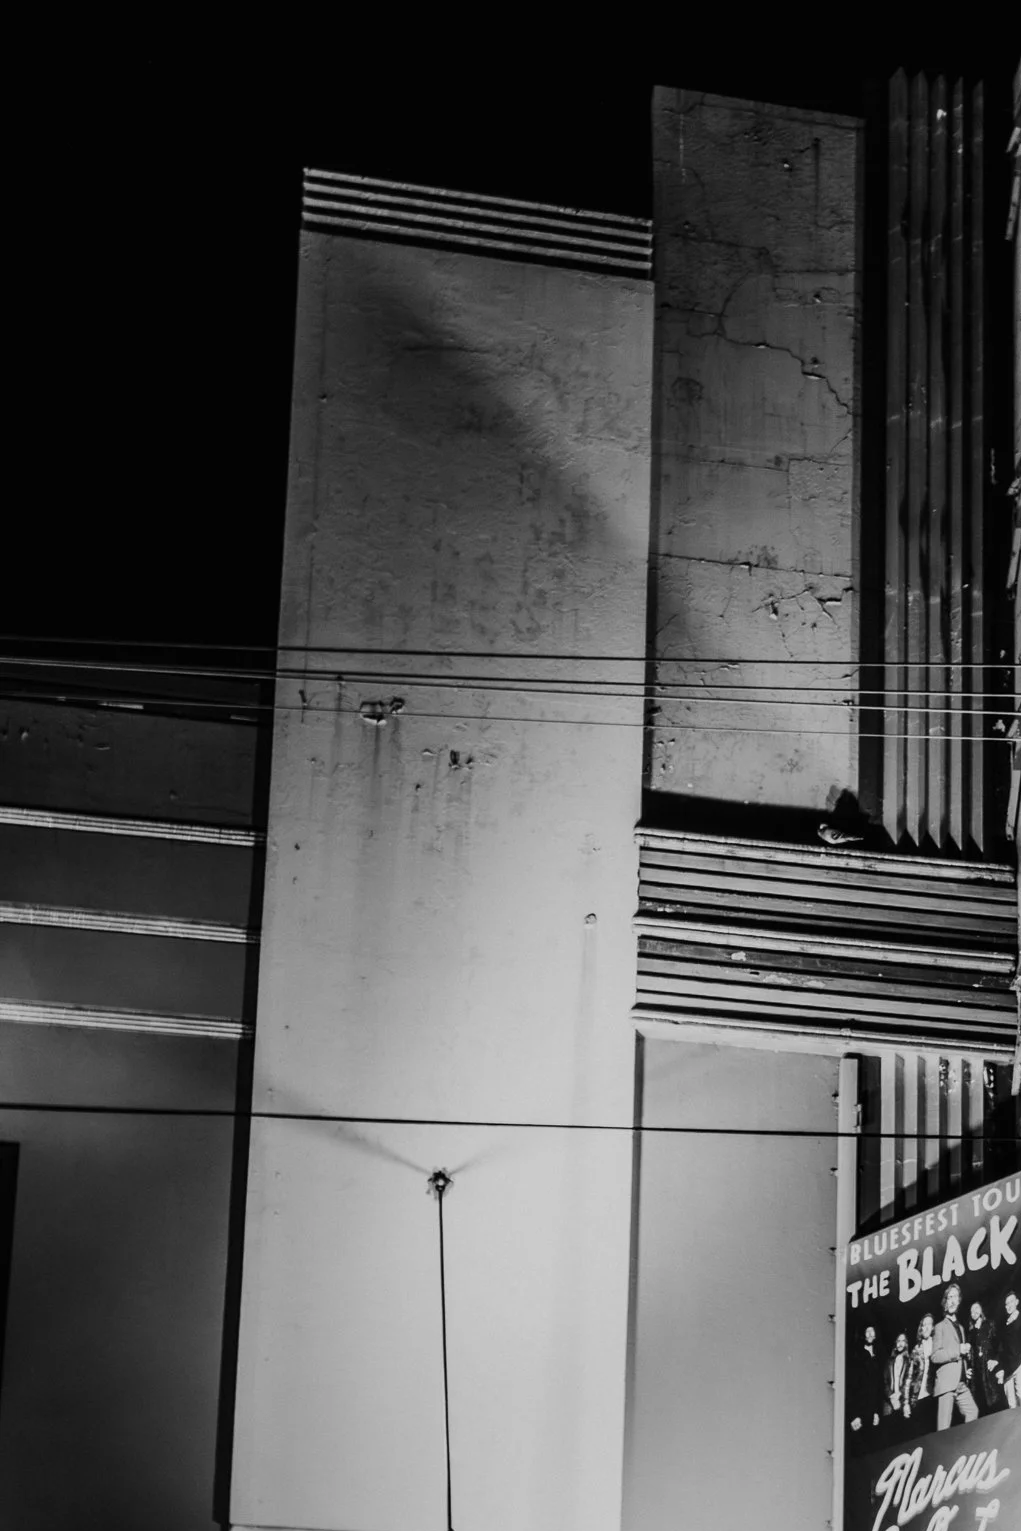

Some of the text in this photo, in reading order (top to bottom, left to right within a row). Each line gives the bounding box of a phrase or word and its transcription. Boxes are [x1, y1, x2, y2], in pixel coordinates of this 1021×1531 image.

[847, 1270, 890, 1308] THE
[897, 1215, 1018, 1302] BLACK
[850, 1203, 959, 1266] BLUESFEST
